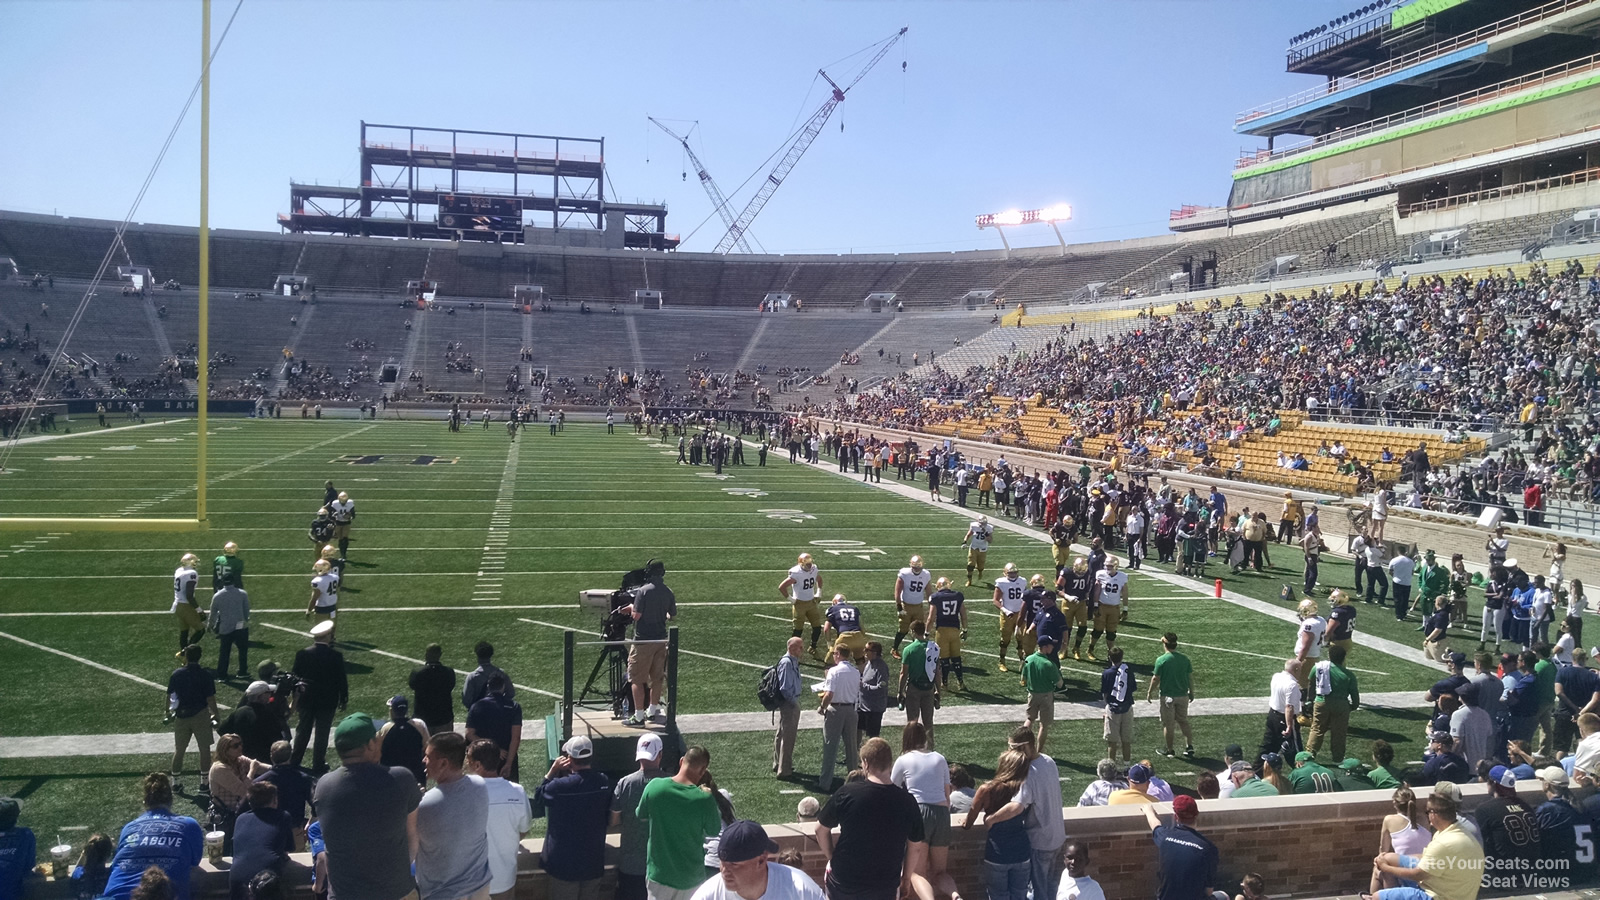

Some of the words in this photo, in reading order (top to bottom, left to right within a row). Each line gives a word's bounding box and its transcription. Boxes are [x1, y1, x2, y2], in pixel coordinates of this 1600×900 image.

[315, 527, 328, 537] 34
[174, 577, 181, 592] 3
[326, 580, 338, 596] 49
[803, 578, 815, 590] 68
[910, 581, 923, 593] 56
[1073, 579, 1085, 590] 70
[1105, 583, 1119, 594] 62
[1008, 588, 1022, 600] 66
[942, 600, 958, 616] 57
[1033, 601, 1041, 613] 5
[840, 608, 855, 622] 67
[1311, 772, 1334, 793] 11
[140, 836, 183, 848] ABOVE
[1574, 824, 1594, 863] 5
